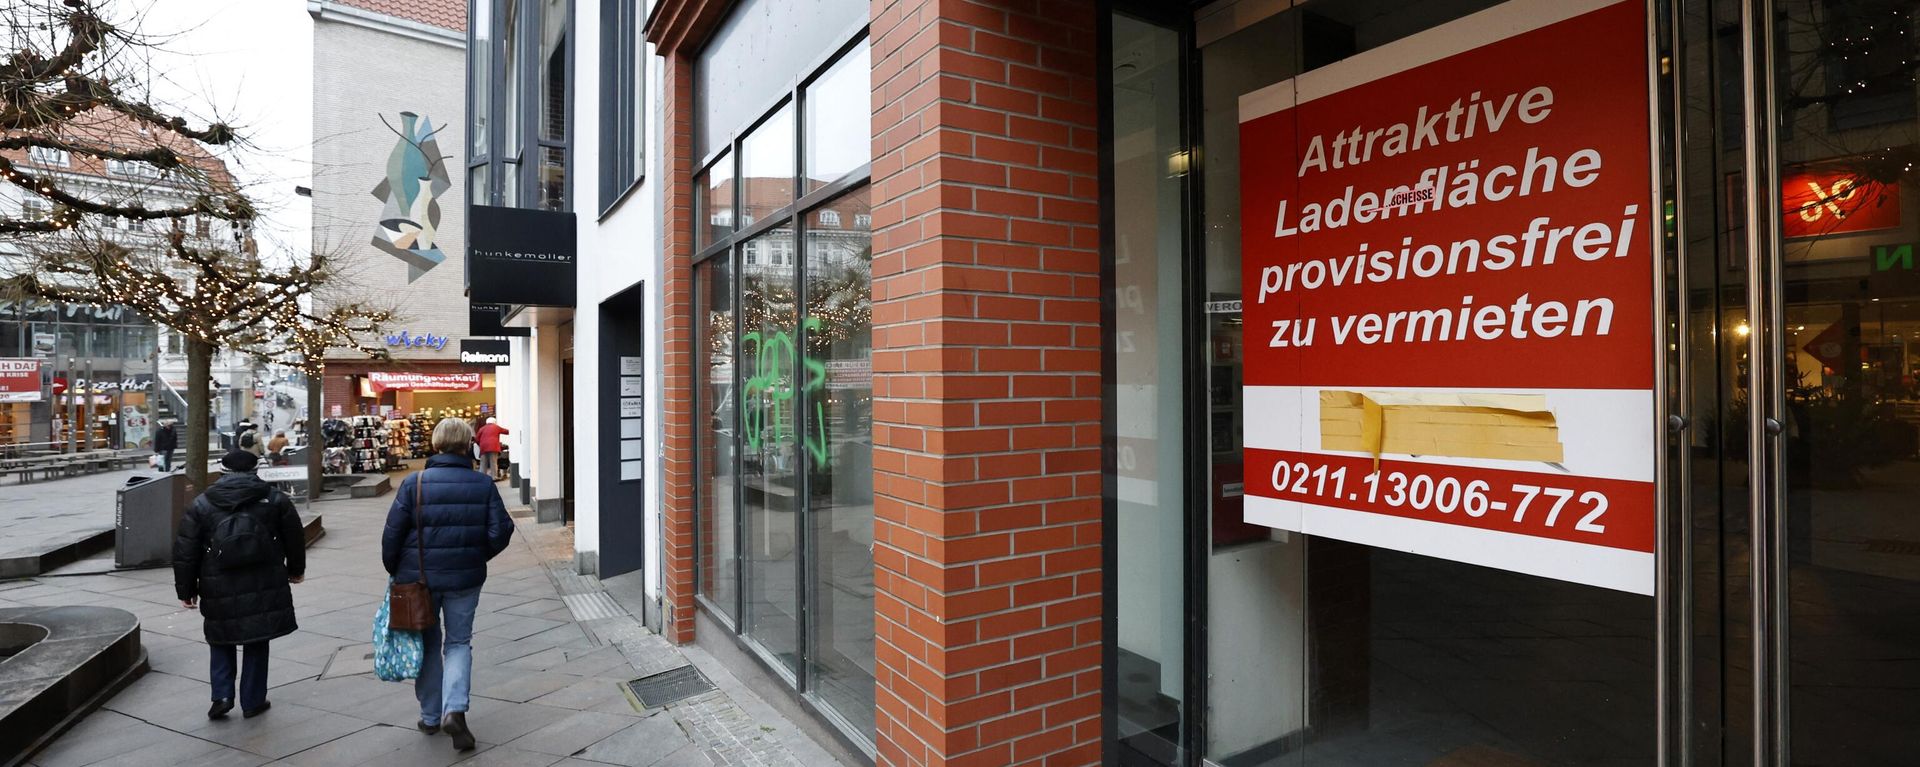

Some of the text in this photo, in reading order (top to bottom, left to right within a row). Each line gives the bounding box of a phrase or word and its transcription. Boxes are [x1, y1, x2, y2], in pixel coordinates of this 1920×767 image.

[1298, 86, 1554, 177] Attraktive
[1274, 147, 1602, 238] Ladenfläche
[1258, 204, 1639, 303] provisionsfrei
[1269, 295, 1614, 348] zu vermieten
[1271, 459, 1610, 535] 0211.13006-772
